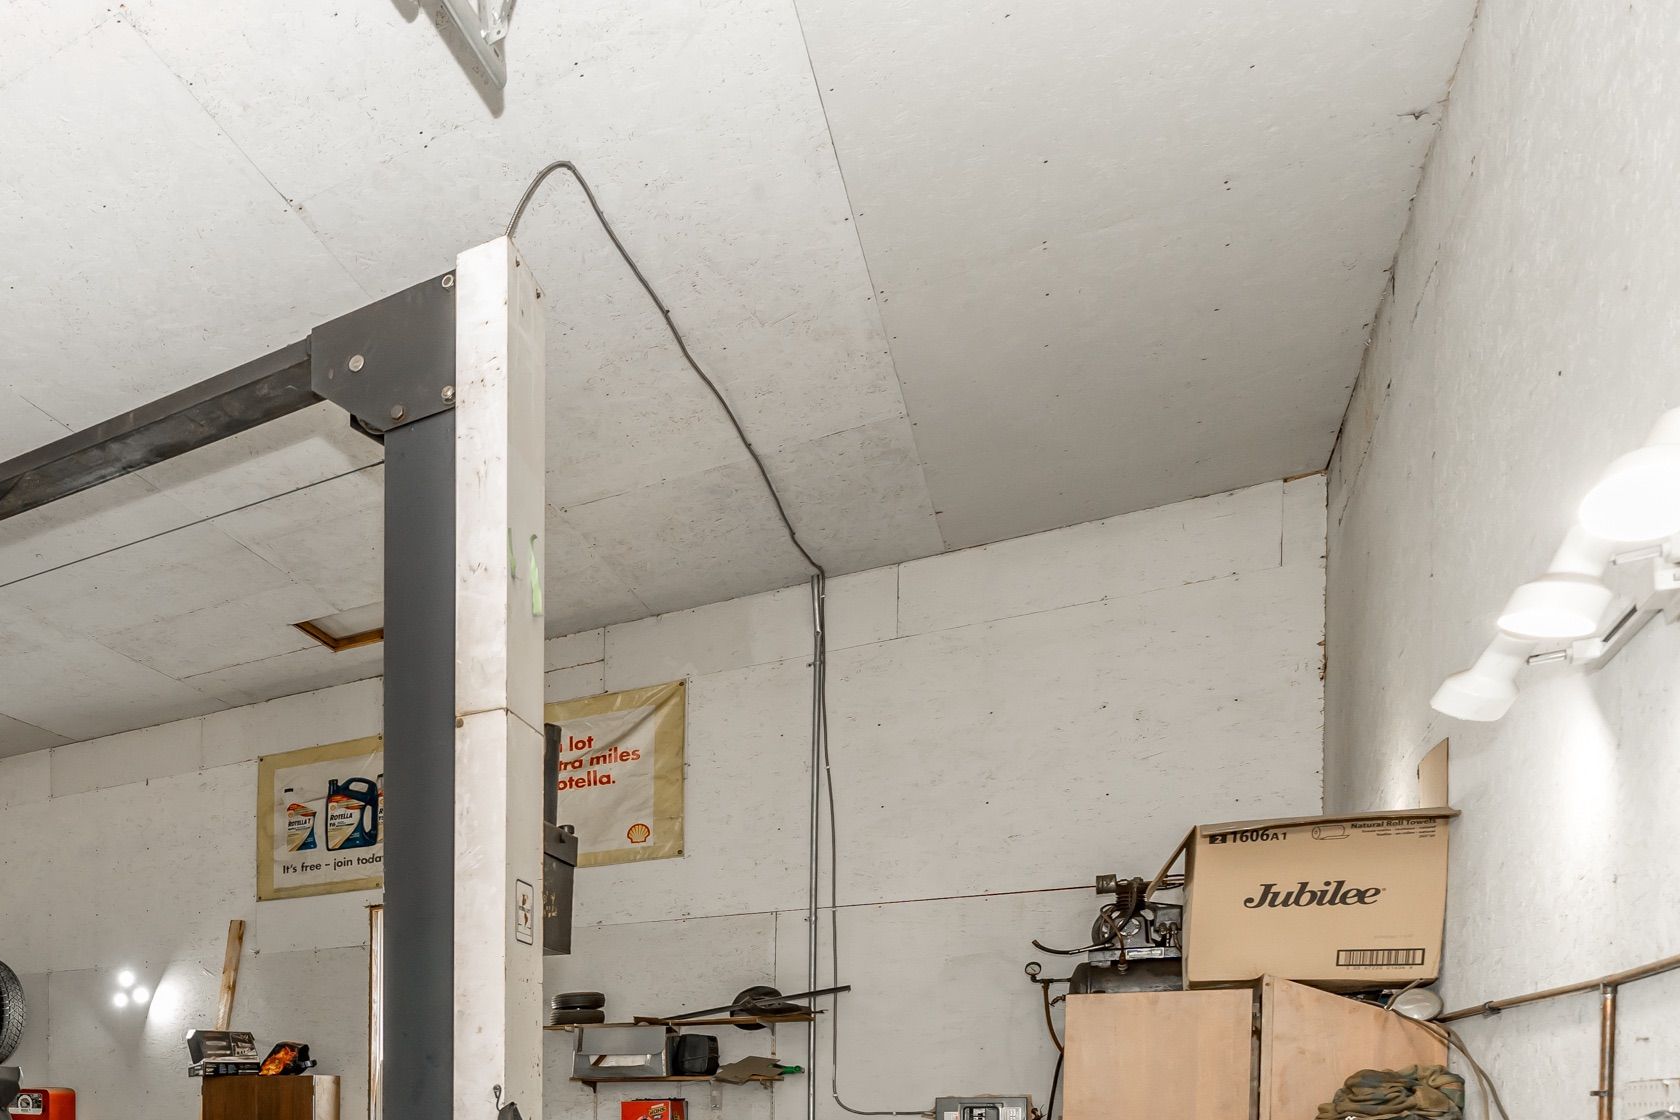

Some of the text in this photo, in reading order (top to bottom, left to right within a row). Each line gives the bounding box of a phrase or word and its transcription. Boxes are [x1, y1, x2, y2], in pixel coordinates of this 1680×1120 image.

[569, 736, 594, 751] lot
[589, 746, 641, 766] miles
[558, 770, 616, 791] otella.
[330, 813, 353, 821] ROTELLA
[1351, 821, 1384, 829] Natural
[283, 864, 297, 874] It's
[301, 862, 321, 872] free
[333, 857, 353, 871] join
[356, 854, 383, 865] toda
[1244, 880, 1381, 909] Jubilee
